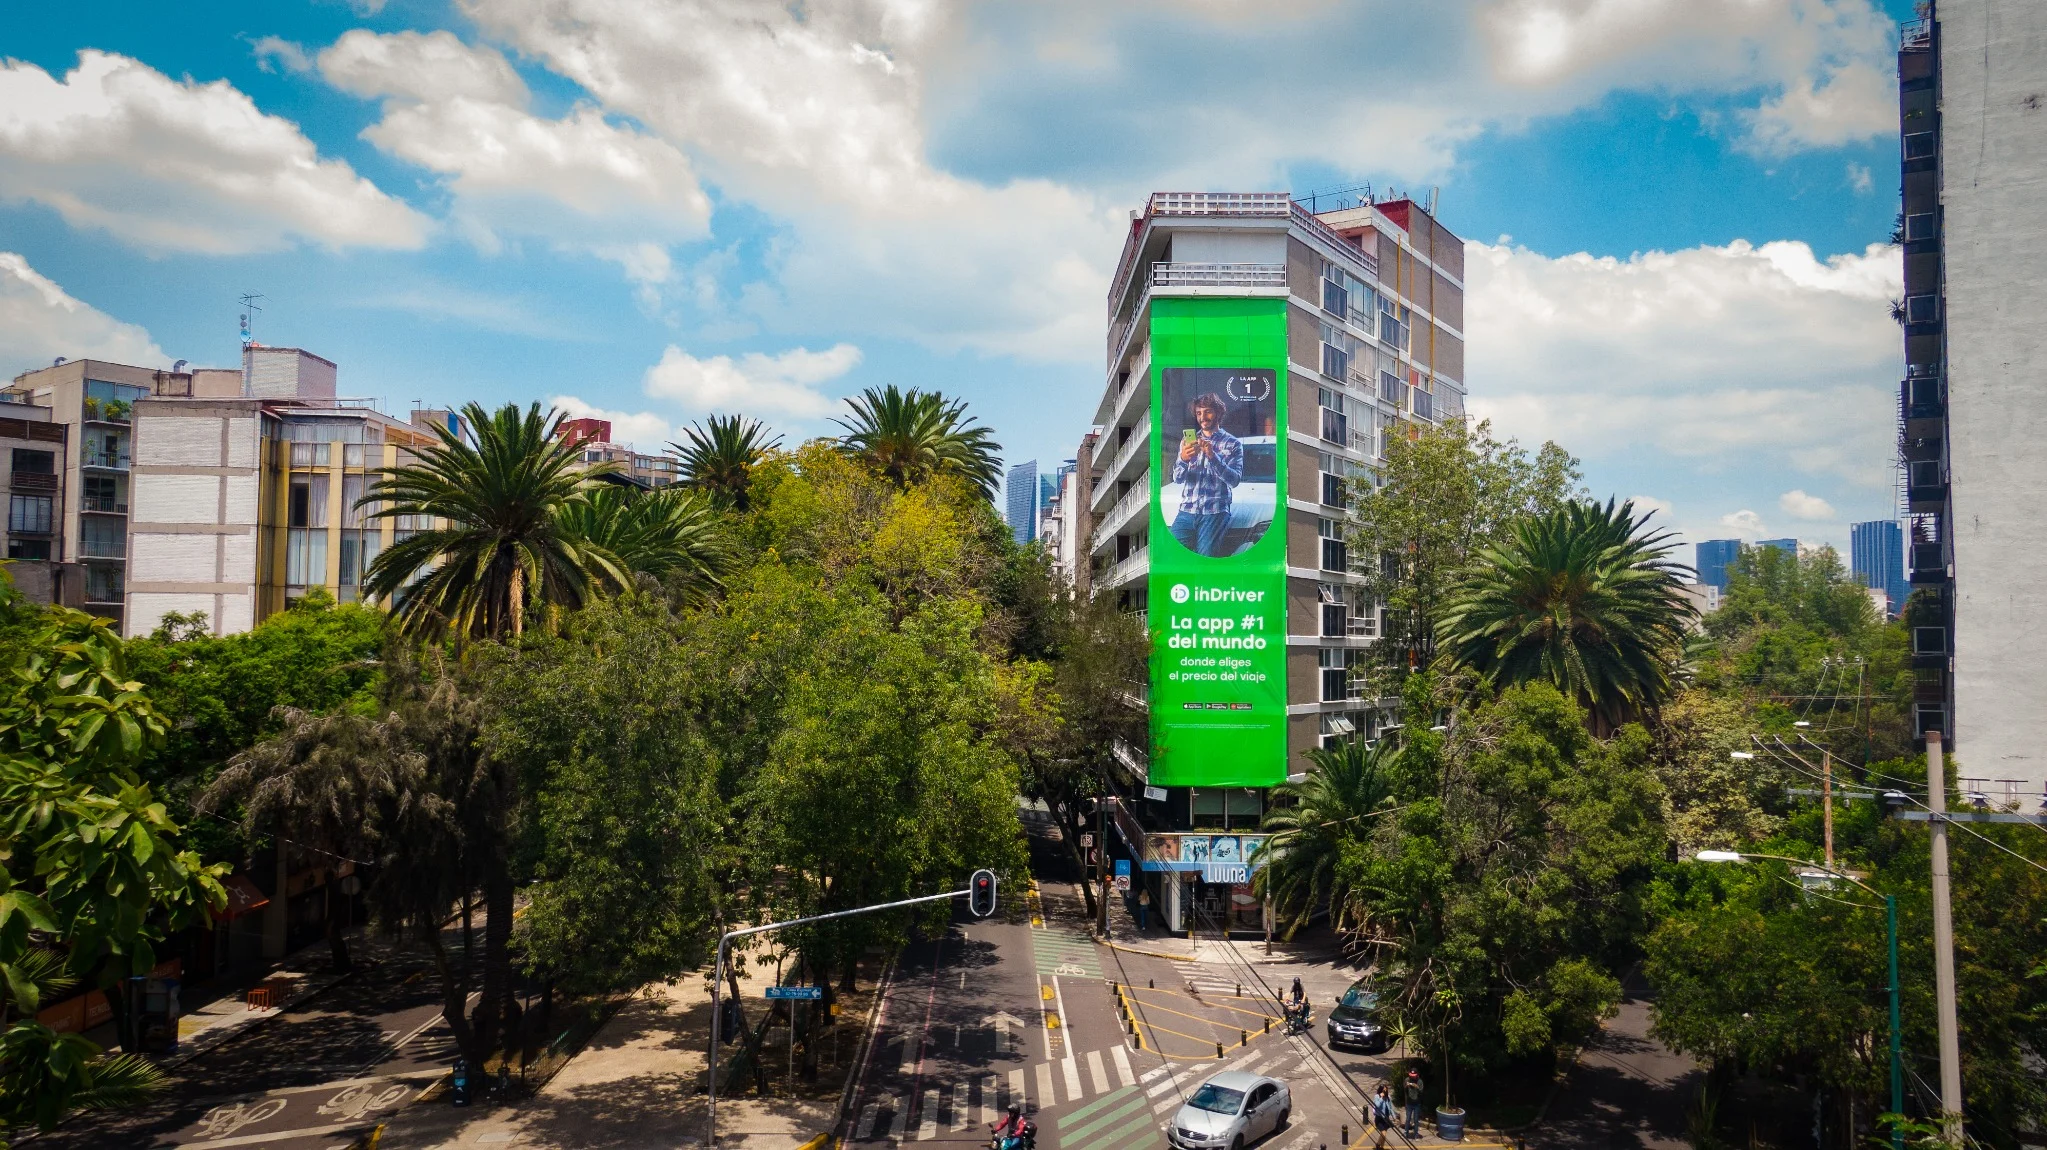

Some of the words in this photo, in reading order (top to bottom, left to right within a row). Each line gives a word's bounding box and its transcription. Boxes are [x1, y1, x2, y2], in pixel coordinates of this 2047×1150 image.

[1245, 383, 1250, 394] 1
[1194, 586, 1264, 602] inDriver
[1171, 615, 1192, 630] La
[1198, 618, 1234, 634] app
[1240, 614, 1264, 630] #1
[1168, 633, 1196, 648] del
[1202, 634, 1266, 649] mundo
[1180, 657, 1215, 667] donde
[1218, 657, 1251, 669] eliges
[1169, 671, 1178, 680] el
[1182, 671, 1217, 682] precio
[1220, 671, 1237, 681] del
[1240, 672, 1266, 683] viaje
[1208, 864, 1246, 883] Luuna
